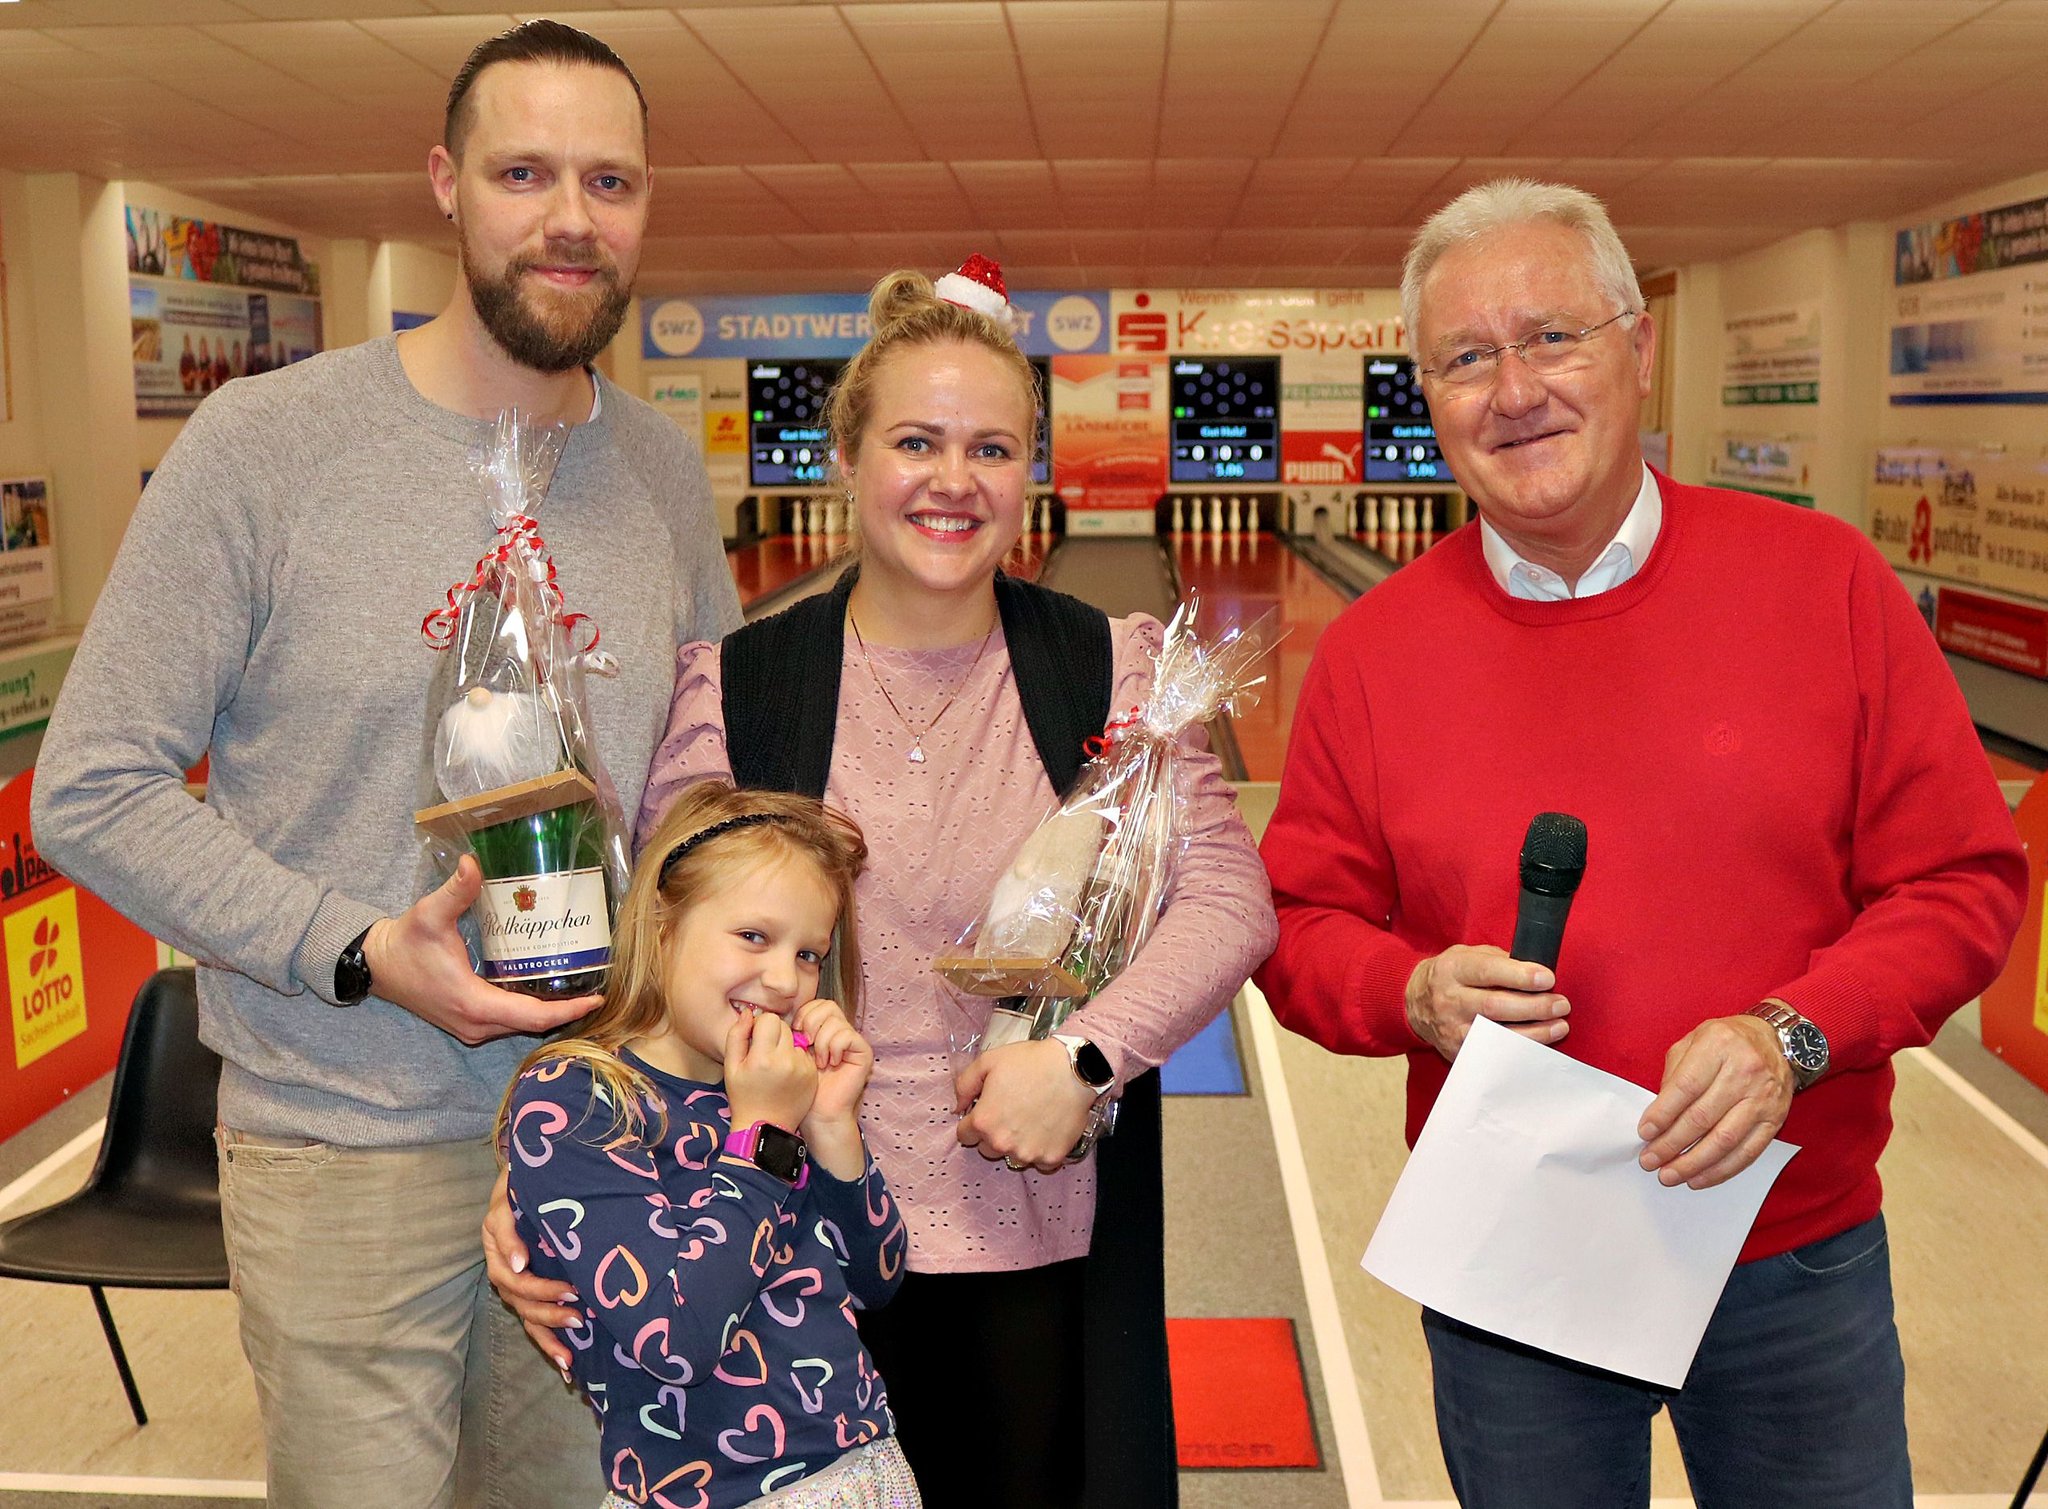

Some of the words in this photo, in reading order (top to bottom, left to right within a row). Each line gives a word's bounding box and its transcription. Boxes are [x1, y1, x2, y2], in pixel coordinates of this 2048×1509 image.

[657, 319, 697, 337] SWZ
[718, 313, 873, 340] STADTWER
[1056, 316, 1094, 332] SWZ
[1285, 461, 1345, 482] PUMA
[483, 908, 592, 939] Rotkäppchen
[503, 958, 570, 971] HALBTROCKEN
[23, 974, 73, 1022] LOTTO
